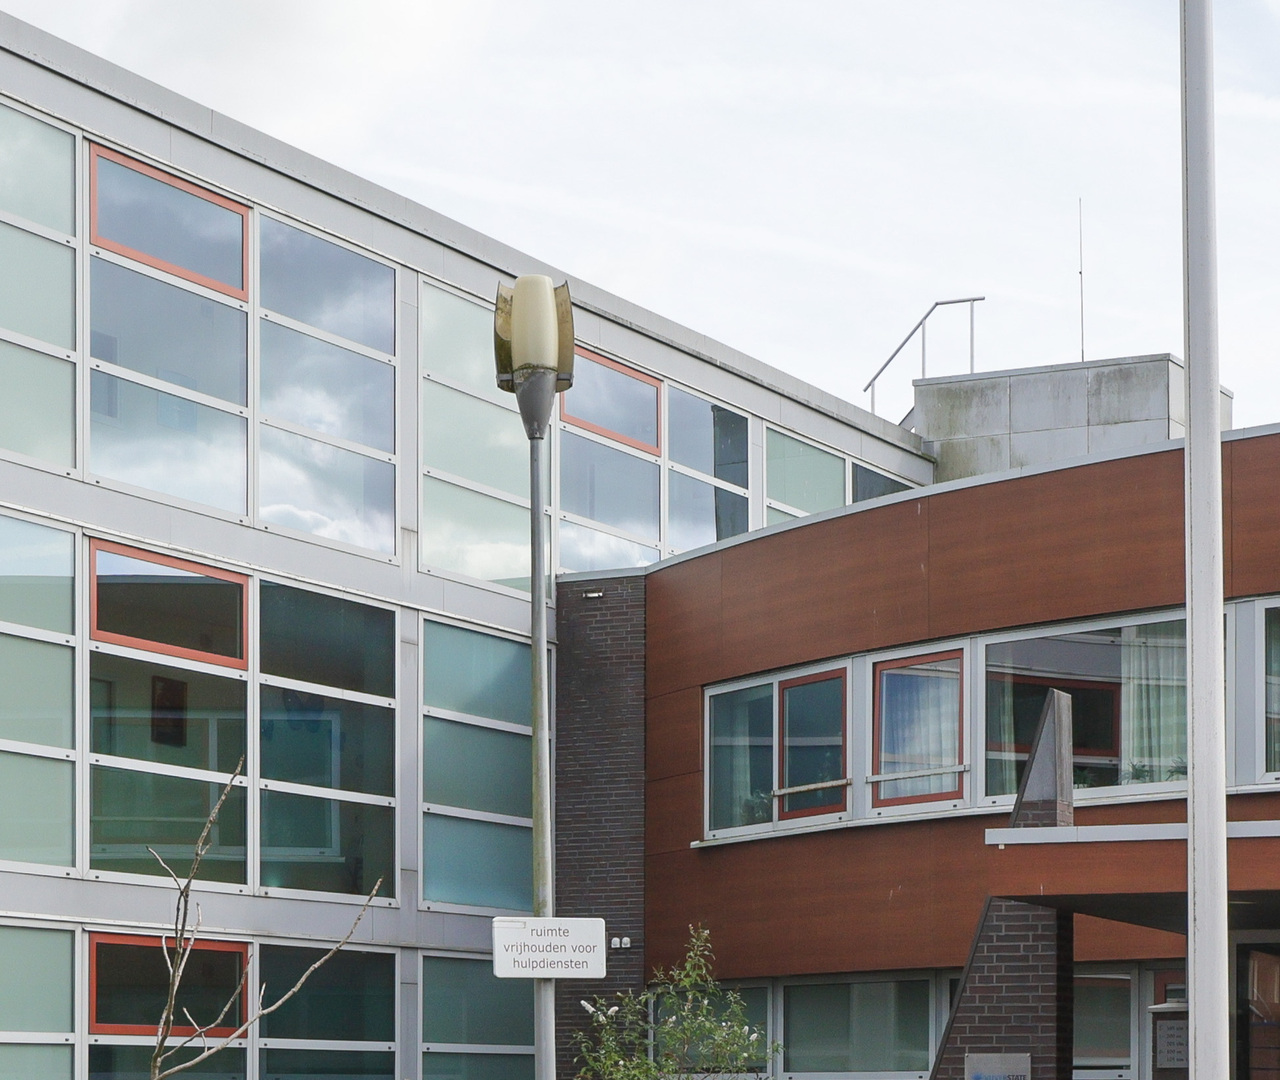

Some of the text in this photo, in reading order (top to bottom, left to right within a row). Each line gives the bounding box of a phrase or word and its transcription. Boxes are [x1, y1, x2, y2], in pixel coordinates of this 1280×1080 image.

[530, 926, 570, 937] ruimte
[503, 942, 598, 955] vrijhouden voor
[513, 958, 589, 971] hulpdiensten
